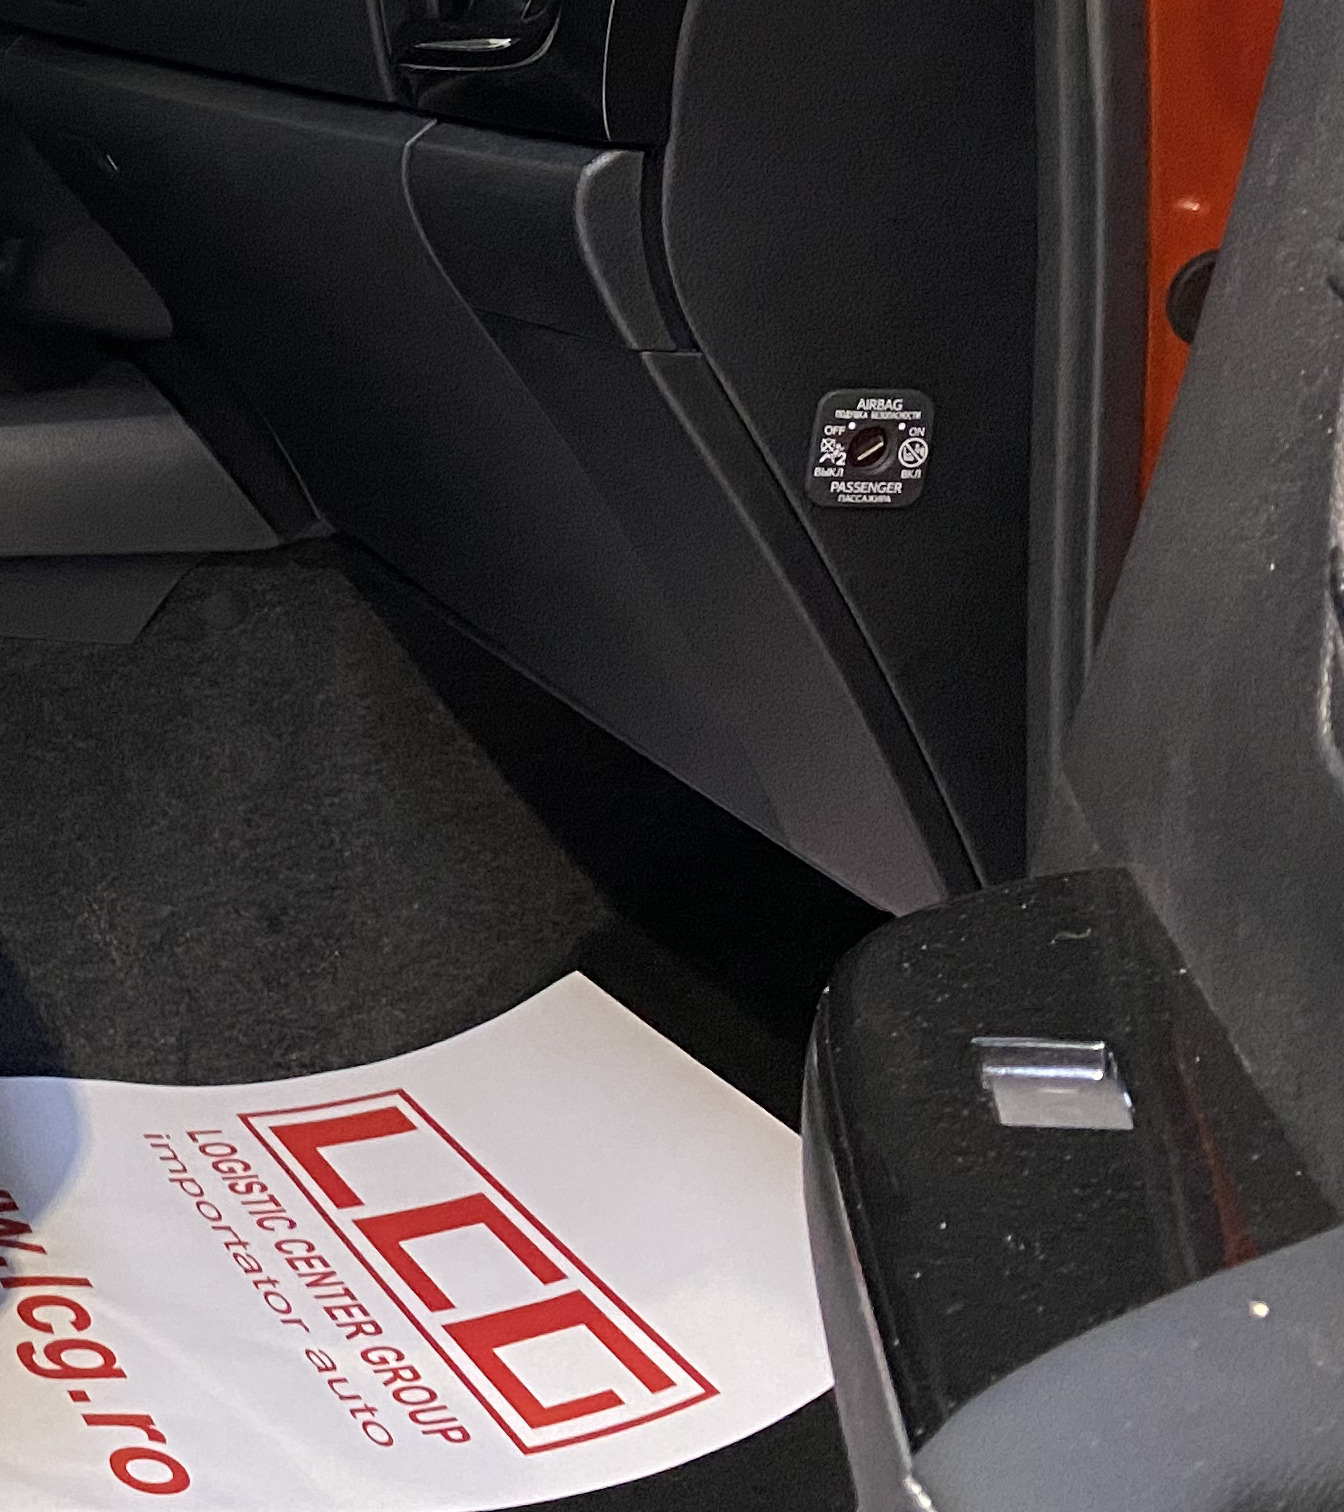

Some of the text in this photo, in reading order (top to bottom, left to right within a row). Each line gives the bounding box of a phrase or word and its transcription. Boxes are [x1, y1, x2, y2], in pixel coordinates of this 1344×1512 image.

[856, 398, 904, 410] AIRBAG
[824, 425, 846, 436] OFF
[909, 427, 926, 437] ON
[900, 469, 922, 479] ВКЛ
[830, 481, 903, 494] PASSENGER
[269, 1106, 677, 1429] LCG
[143, 1133, 394, 1447] importator auto
[186, 1130, 471, 1444] LOGISTIC CENTER GROUP
